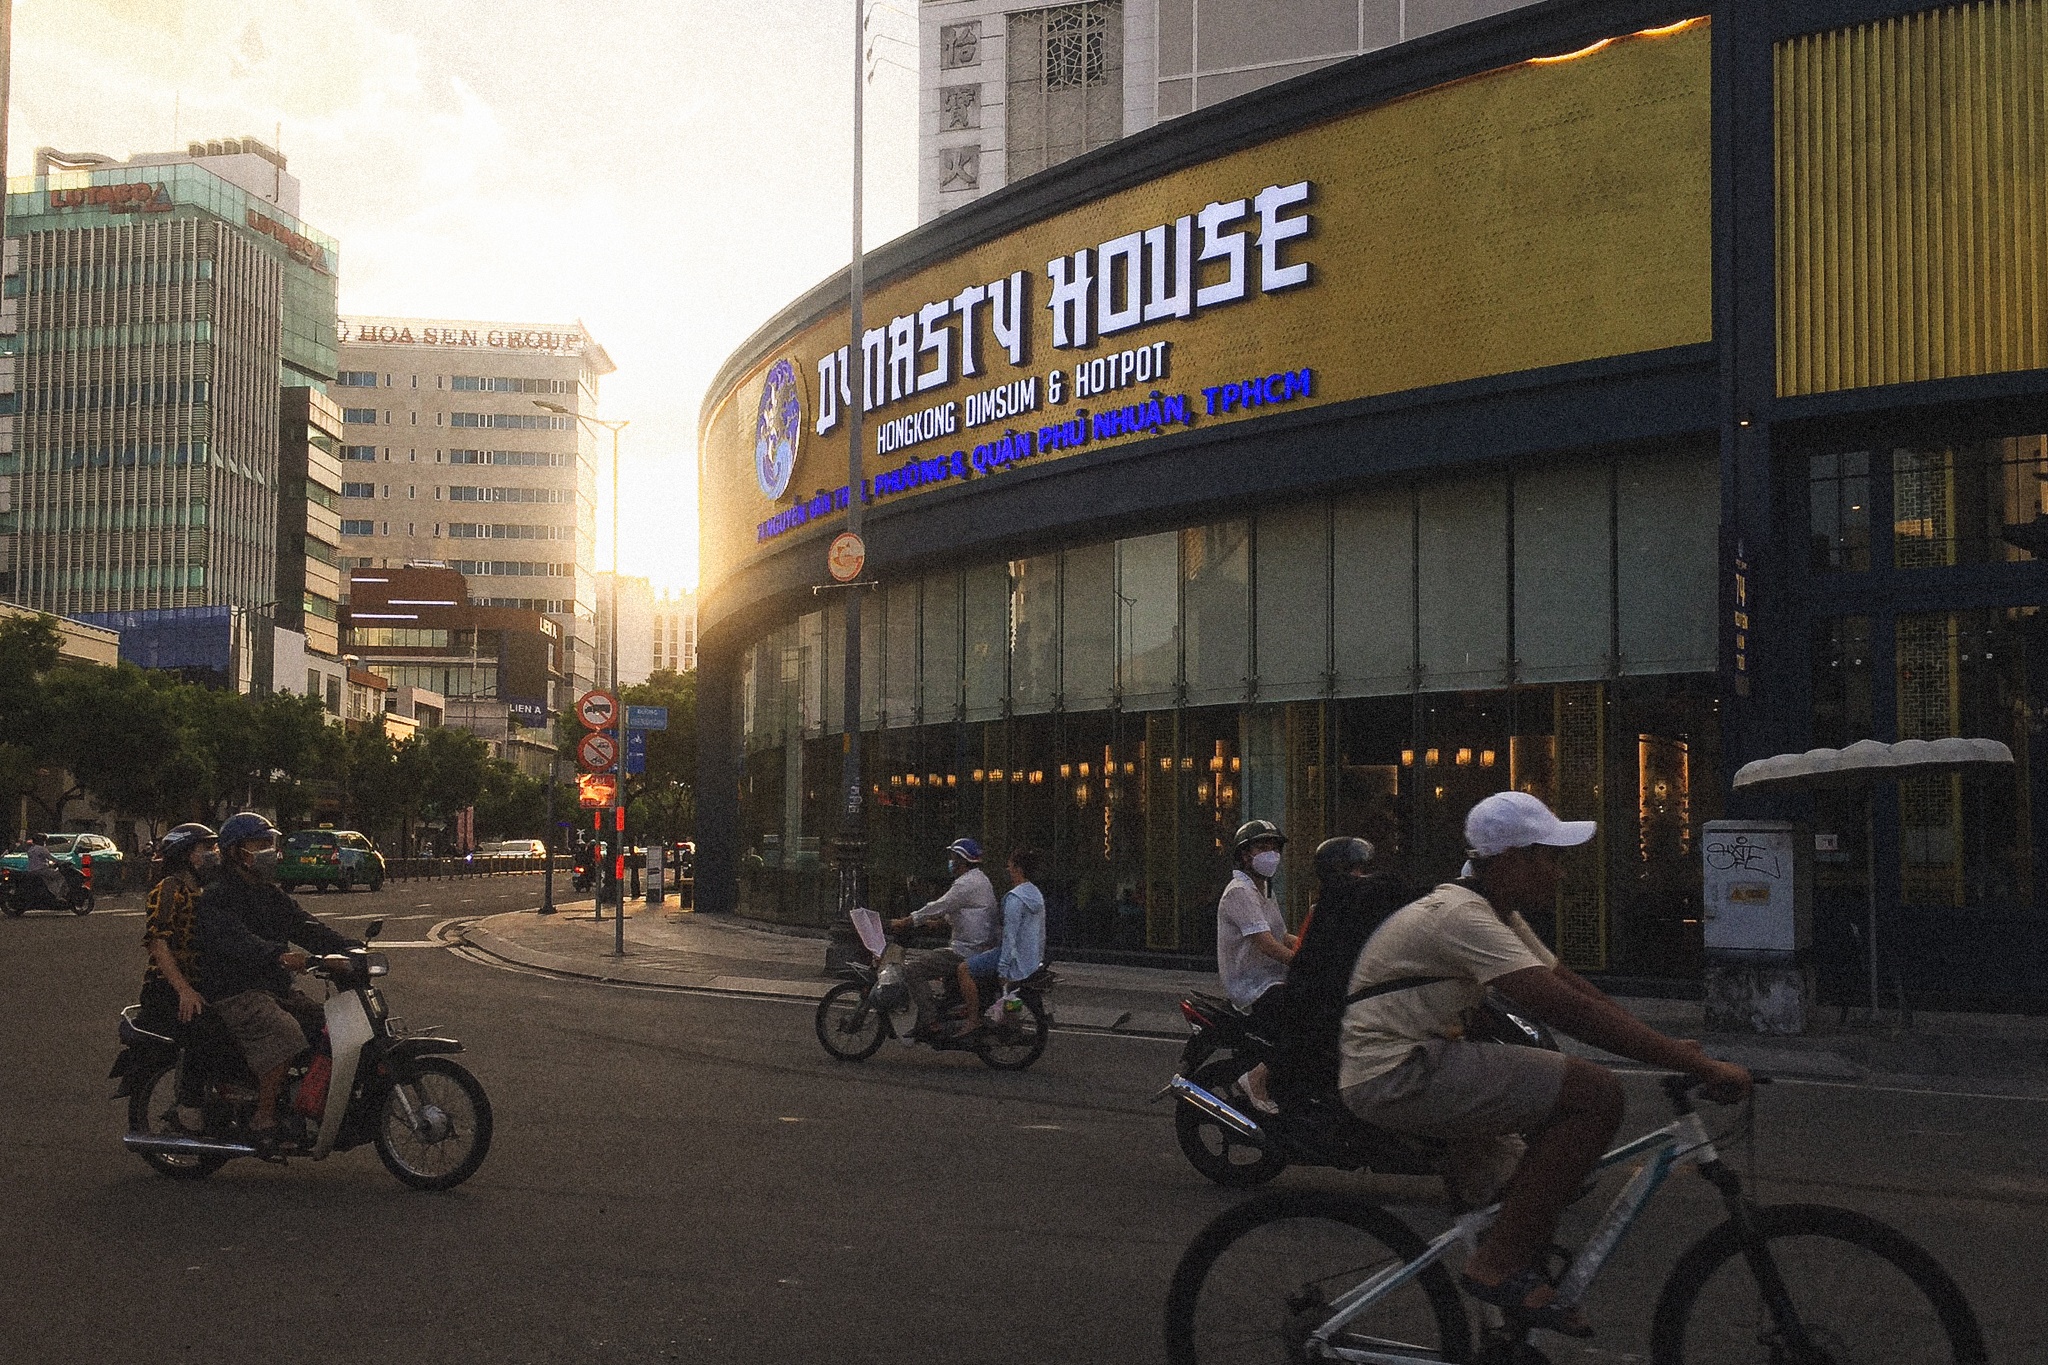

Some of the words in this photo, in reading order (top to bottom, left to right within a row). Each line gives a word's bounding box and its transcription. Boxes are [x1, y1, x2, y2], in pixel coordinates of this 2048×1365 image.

[1047, 180, 1309, 349] HOUSE
[358, 325, 415, 344] HOA
[423, 328, 477, 347] SEN
[487, 330, 580, 350] GROUP
[876, 401, 955, 455] HONGKONG
[965, 376, 1036, 428] DIMSUM
[1048, 370, 1061, 404] &
[1076, 341, 1168, 398] HOTPOT
[1201, 368, 1312, 416] TPHCM
[509, 704, 532, 714] LIEN
